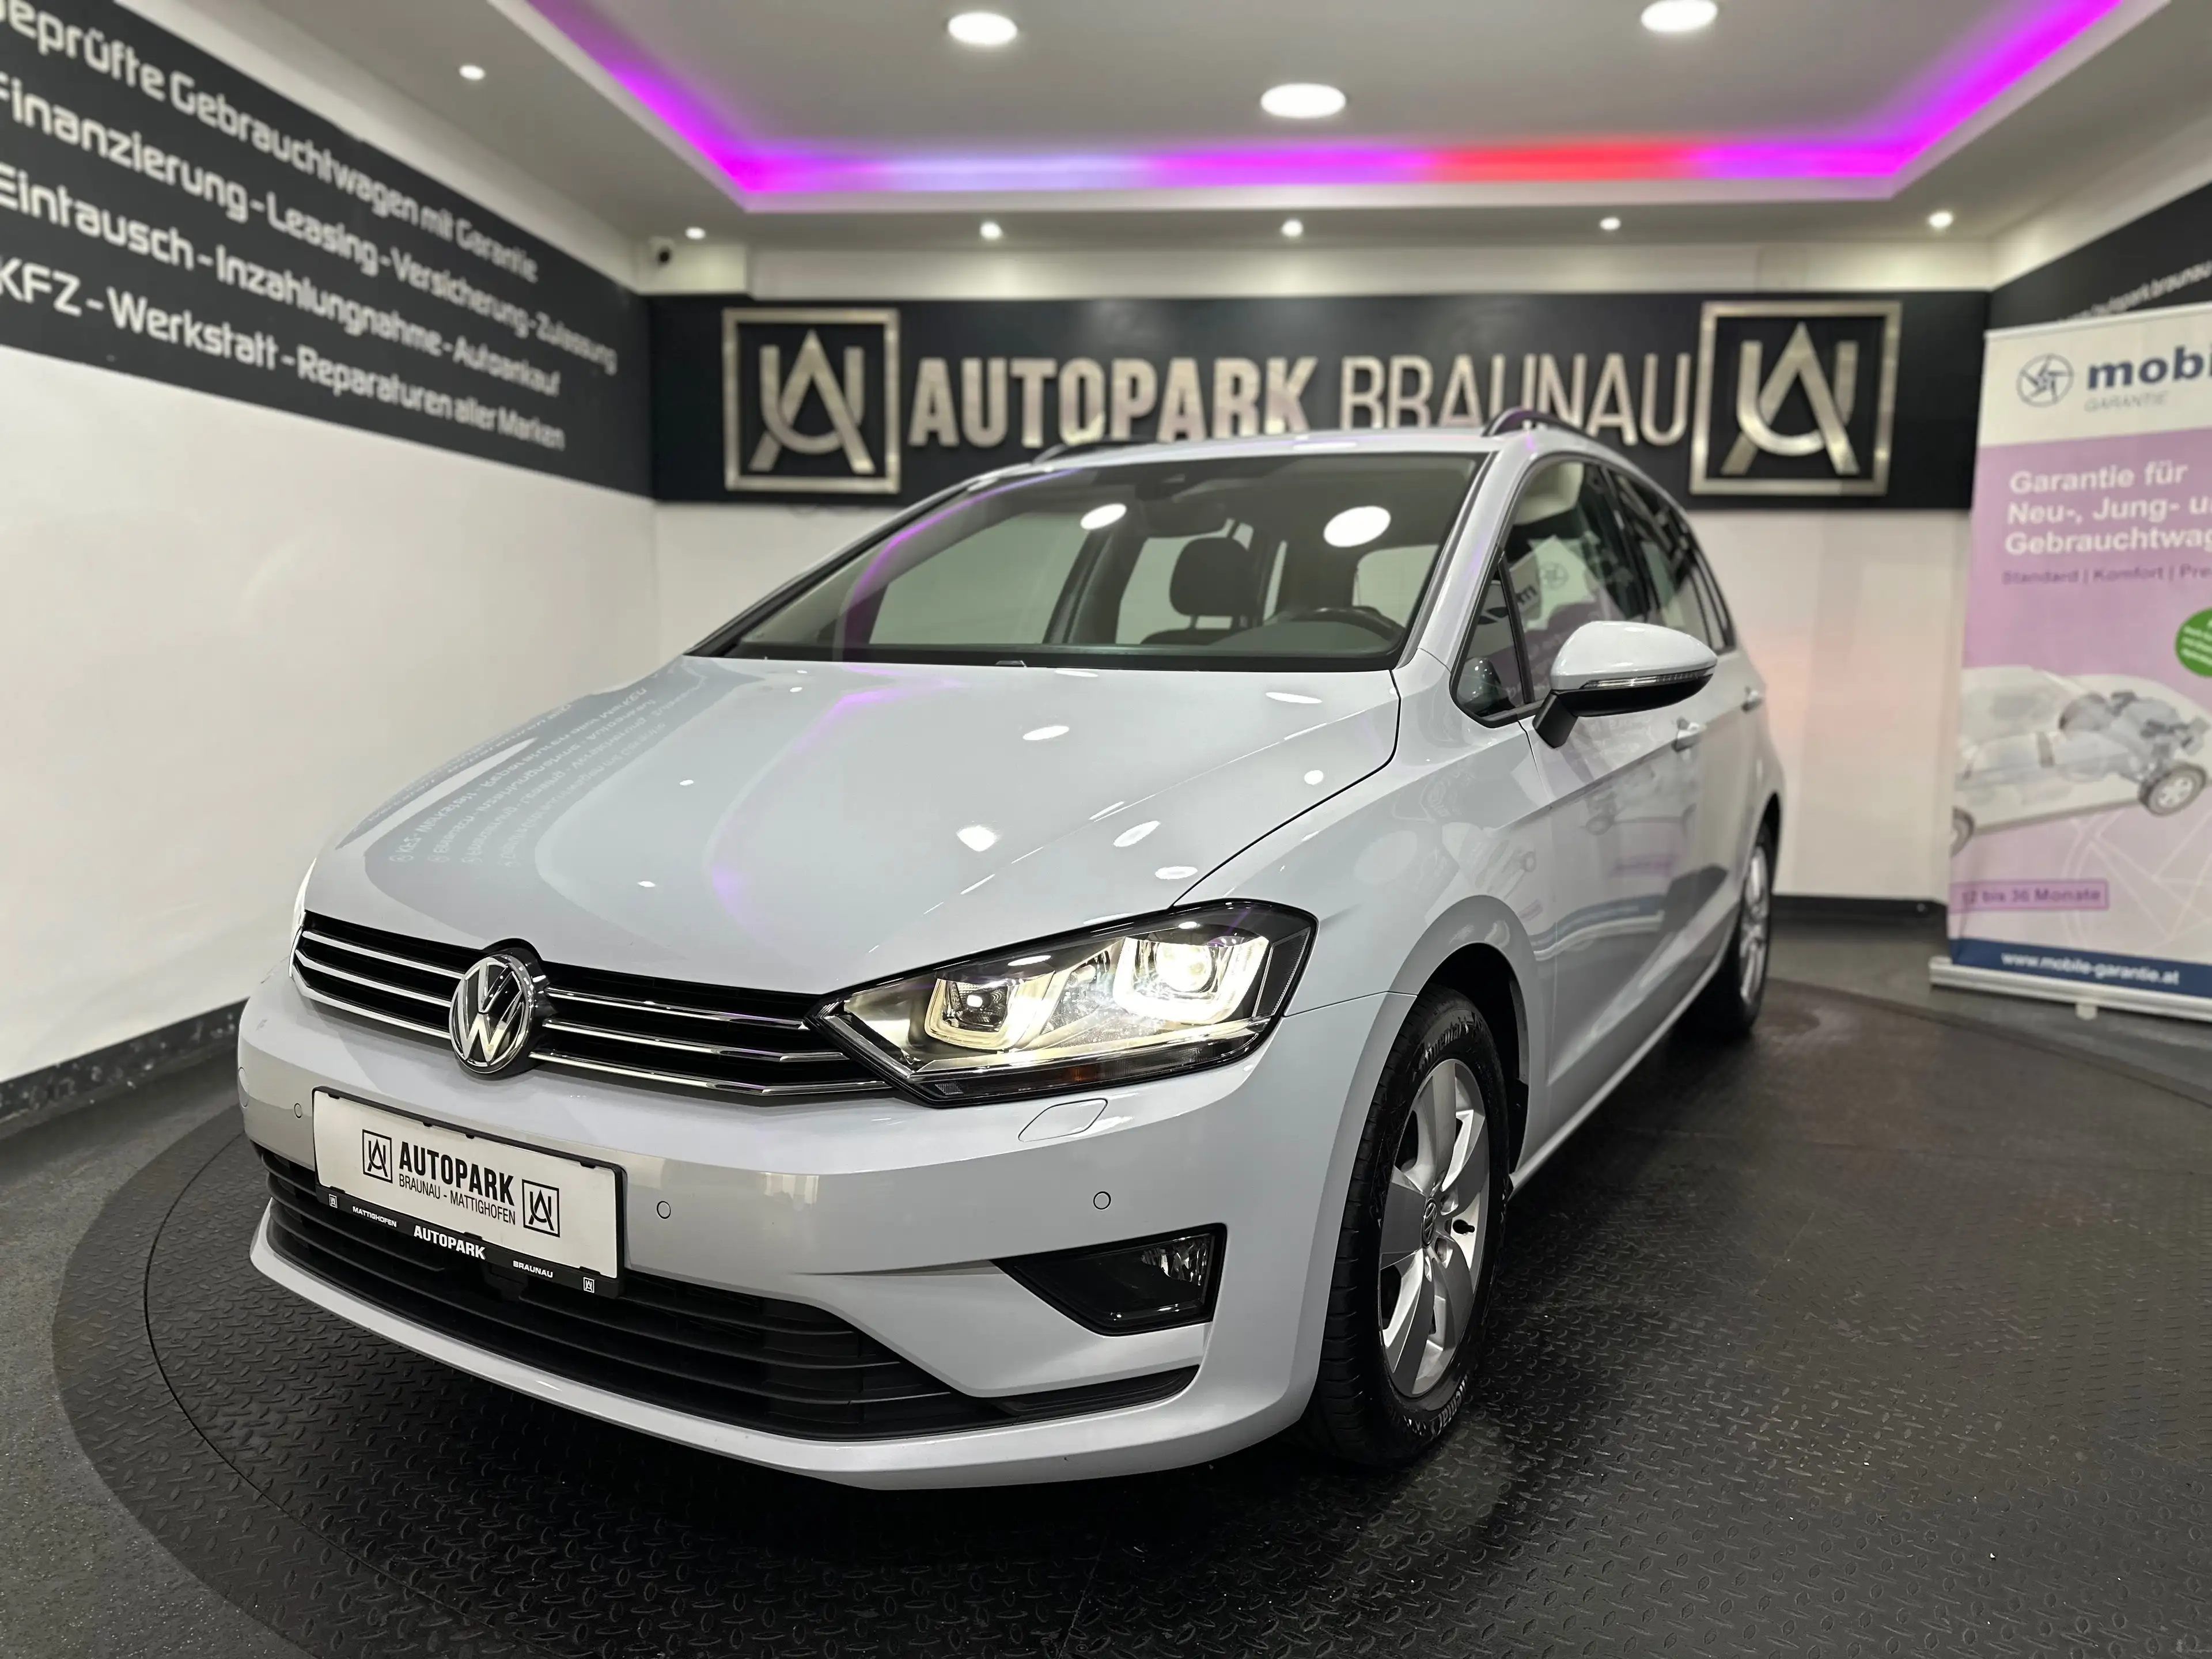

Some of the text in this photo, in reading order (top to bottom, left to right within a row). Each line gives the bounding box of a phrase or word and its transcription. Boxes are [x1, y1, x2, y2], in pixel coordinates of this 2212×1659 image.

[0, 0, 539, 284] eprüfte Gebrauchtwagen mit Garantie
[266, 191, 379, 278] Leasing
[389, 246, 529, 339] Versicherung
[215, 244, 443, 358] Inzahlungnahme
[0, 256, 82, 318] KFZ
[106, 286, 279, 371] Werkstatt
[296, 344, 452, 420] Reparaturen
[453, 396, 499, 432] aller
[498, 406, 566, 452] Marken
[2086, 344, 2212, 391] mob
[907, 352, 1692, 449] AUTOPARK BRAUNAU
[2009, 460, 2188, 495] Garantie für
[2092, 496, 2180, 524] Jung-
[2189, 495, 2212, 515] u
[2033, 887, 2101, 902] Monate
[2000, 952, 2180, 986] www.mobile-garantie.at
[399, 1141, 515, 1207] AUTOPARK
[352, 1205, 397, 1228] MATTIGHOFEN
[399, 1173, 441, 1200] BRAUNAU
[449, 1189, 516, 1226] MATTIGHOFEN
[412, 1225, 487, 1260] AUTOPARK
[512, 1260, 554, 1278] BRAUNAU
